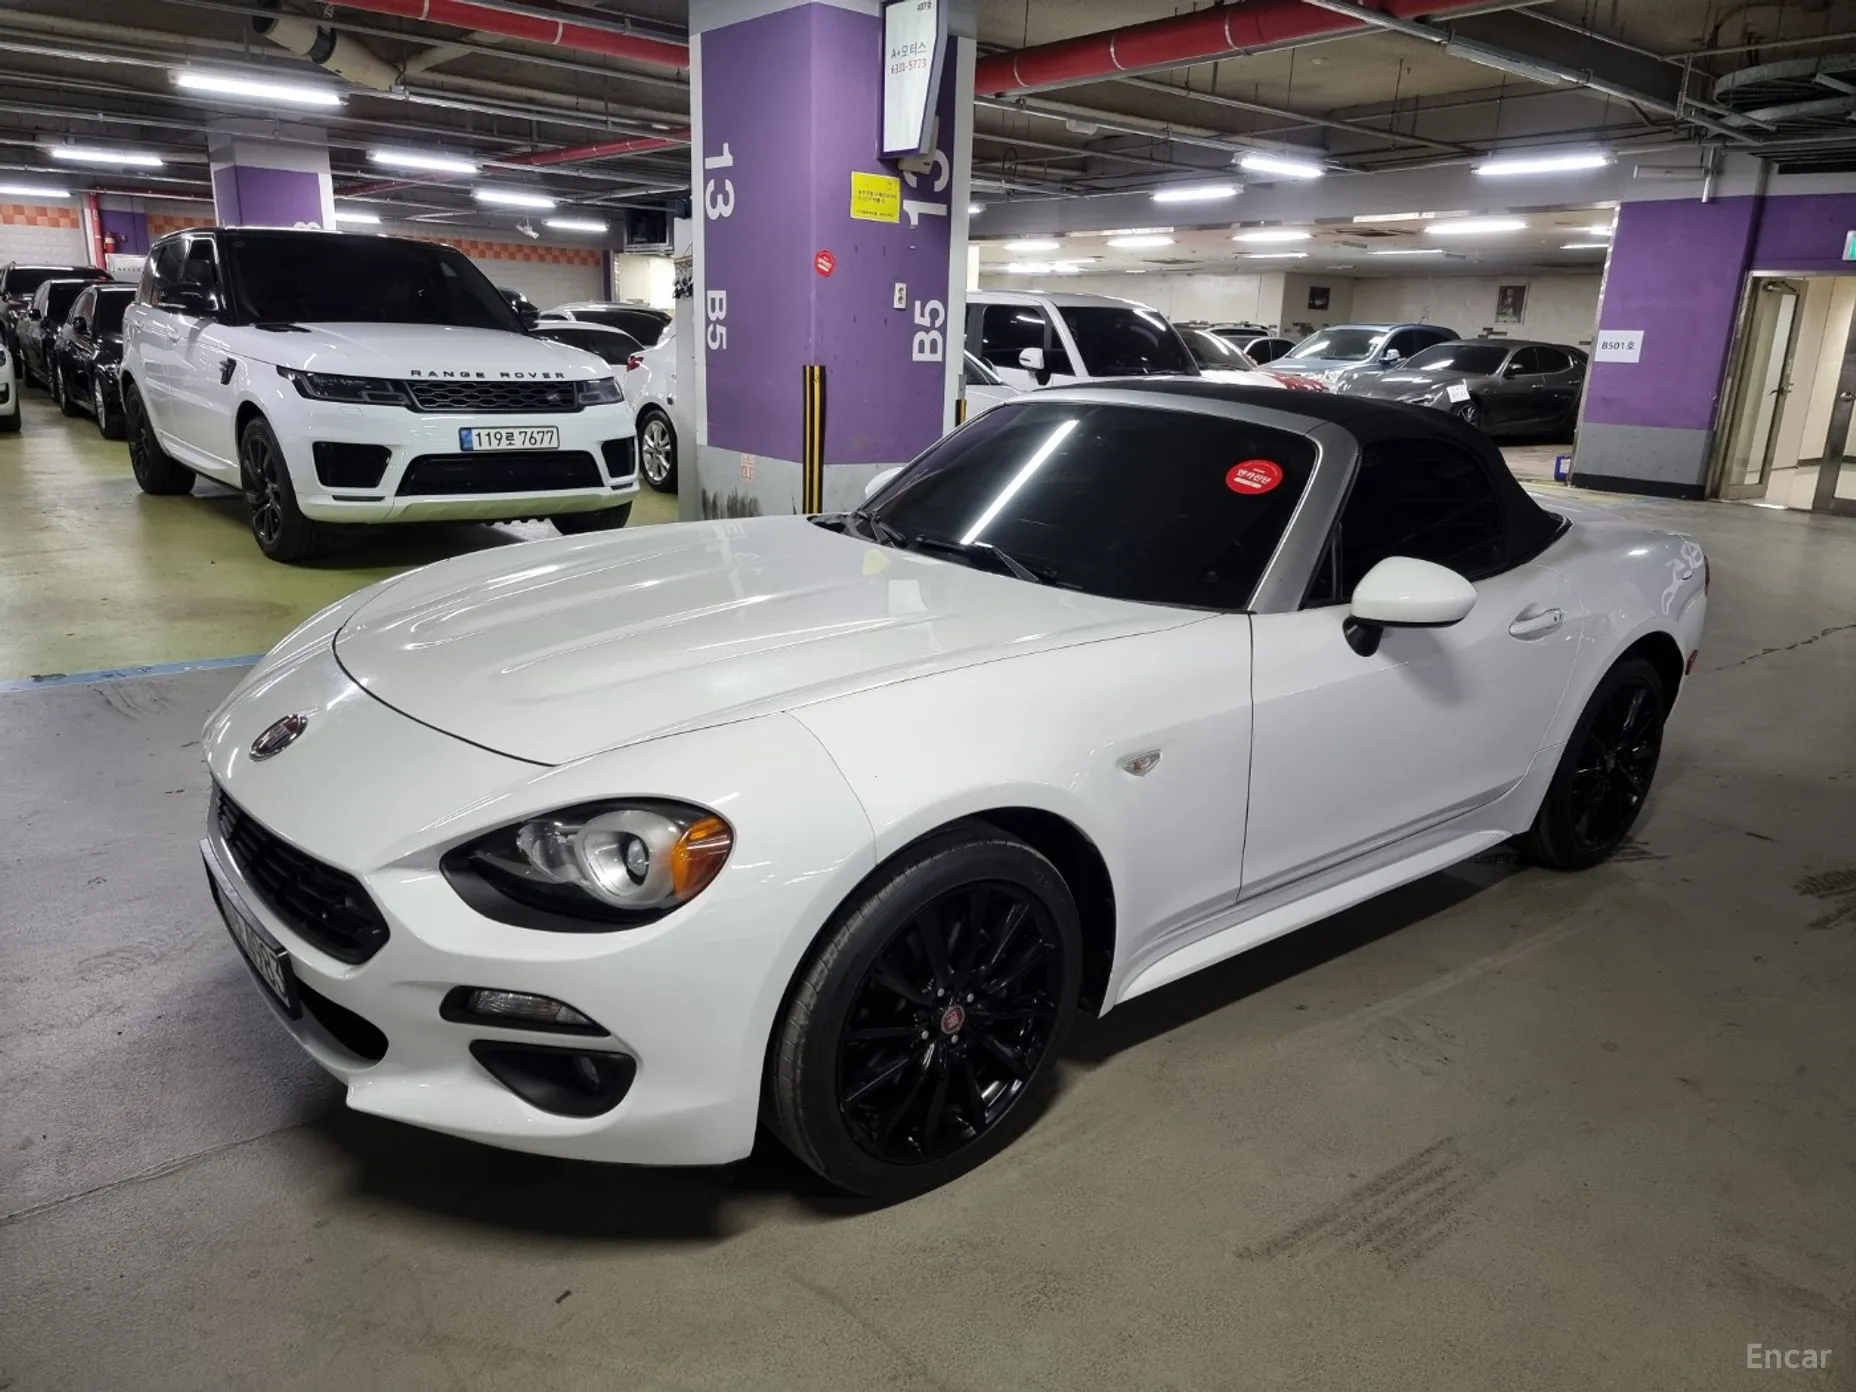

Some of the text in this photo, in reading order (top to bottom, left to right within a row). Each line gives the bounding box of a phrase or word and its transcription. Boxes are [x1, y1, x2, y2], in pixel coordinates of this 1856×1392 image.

[705, 142, 735, 220] 13
[707, 290, 727, 350] B5
[912, 299, 945, 362] B5
[411, 370, 565, 379] RANGE ROVER
